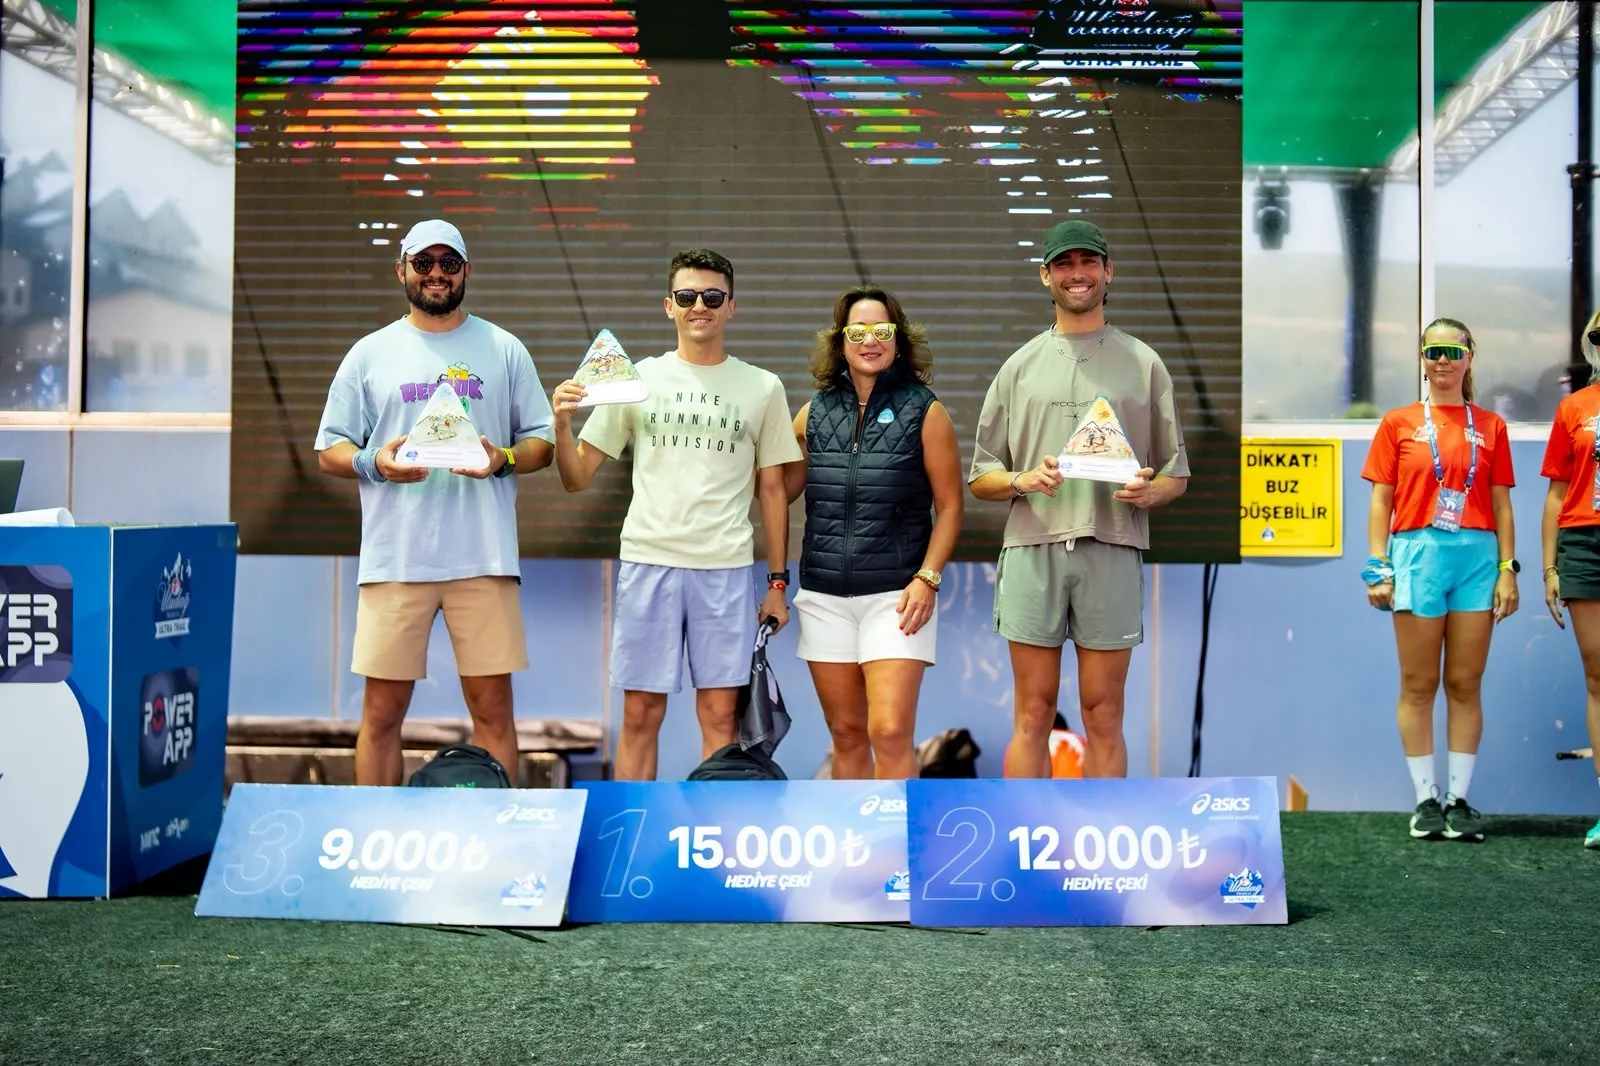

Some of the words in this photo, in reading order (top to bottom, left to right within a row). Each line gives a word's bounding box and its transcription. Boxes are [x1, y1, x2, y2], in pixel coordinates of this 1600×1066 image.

[400, 379, 483, 403] REOK
[676, 392, 720, 406] NIKE
[650, 412, 740, 432] RUNNING
[652, 435, 736, 454] DIVISION
[1246, 449, 1318, 468] DİKKAT!
[1266, 480, 1299, 493] BUZ
[1240, 502, 1327, 522] DÜŞEBİLİR
[0, 632, 59, 667] PP
[144, 692, 194, 736] POWER
[163, 727, 193, 765] APP
[222, 809, 305, 897] 3.
[597, 808, 654, 898] 1.
[922, 807, 1016, 902] 2.
[724, 871, 777, 888] HEDİYE
[778, 871, 813, 890] ÇEKİ
[1063, 874, 1115, 891] HEDİYE
[1115, 874, 1149, 893] ÇEKİ
